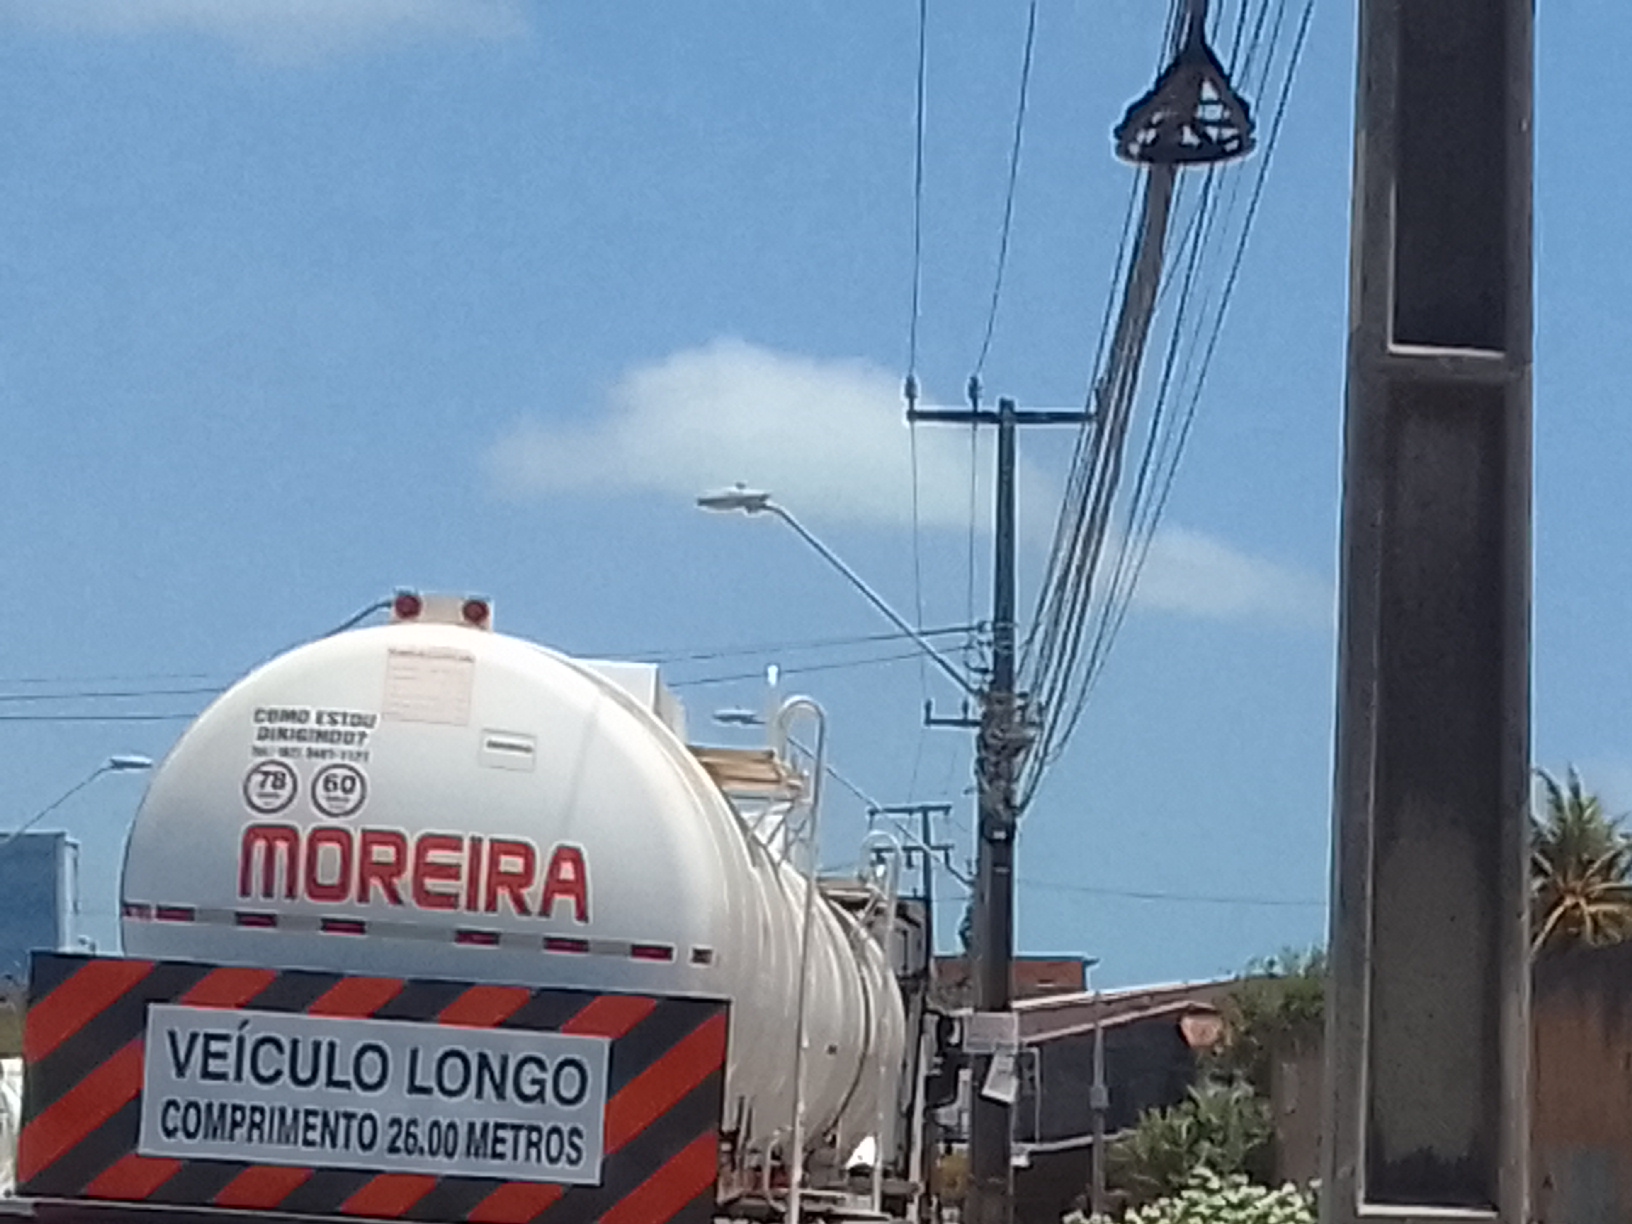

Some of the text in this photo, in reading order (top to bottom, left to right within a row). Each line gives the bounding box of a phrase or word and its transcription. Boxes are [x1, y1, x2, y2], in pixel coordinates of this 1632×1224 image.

[254, 709, 377, 729] COMO ESTOU
[323, 773, 356, 795] 60
[239, 824, 589, 923] MOREIRA
[166, 1020, 589, 1106] VEÍCULO LONGO
[160, 1099, 585, 1167] COMPRIMENTO 26.00 METROS
